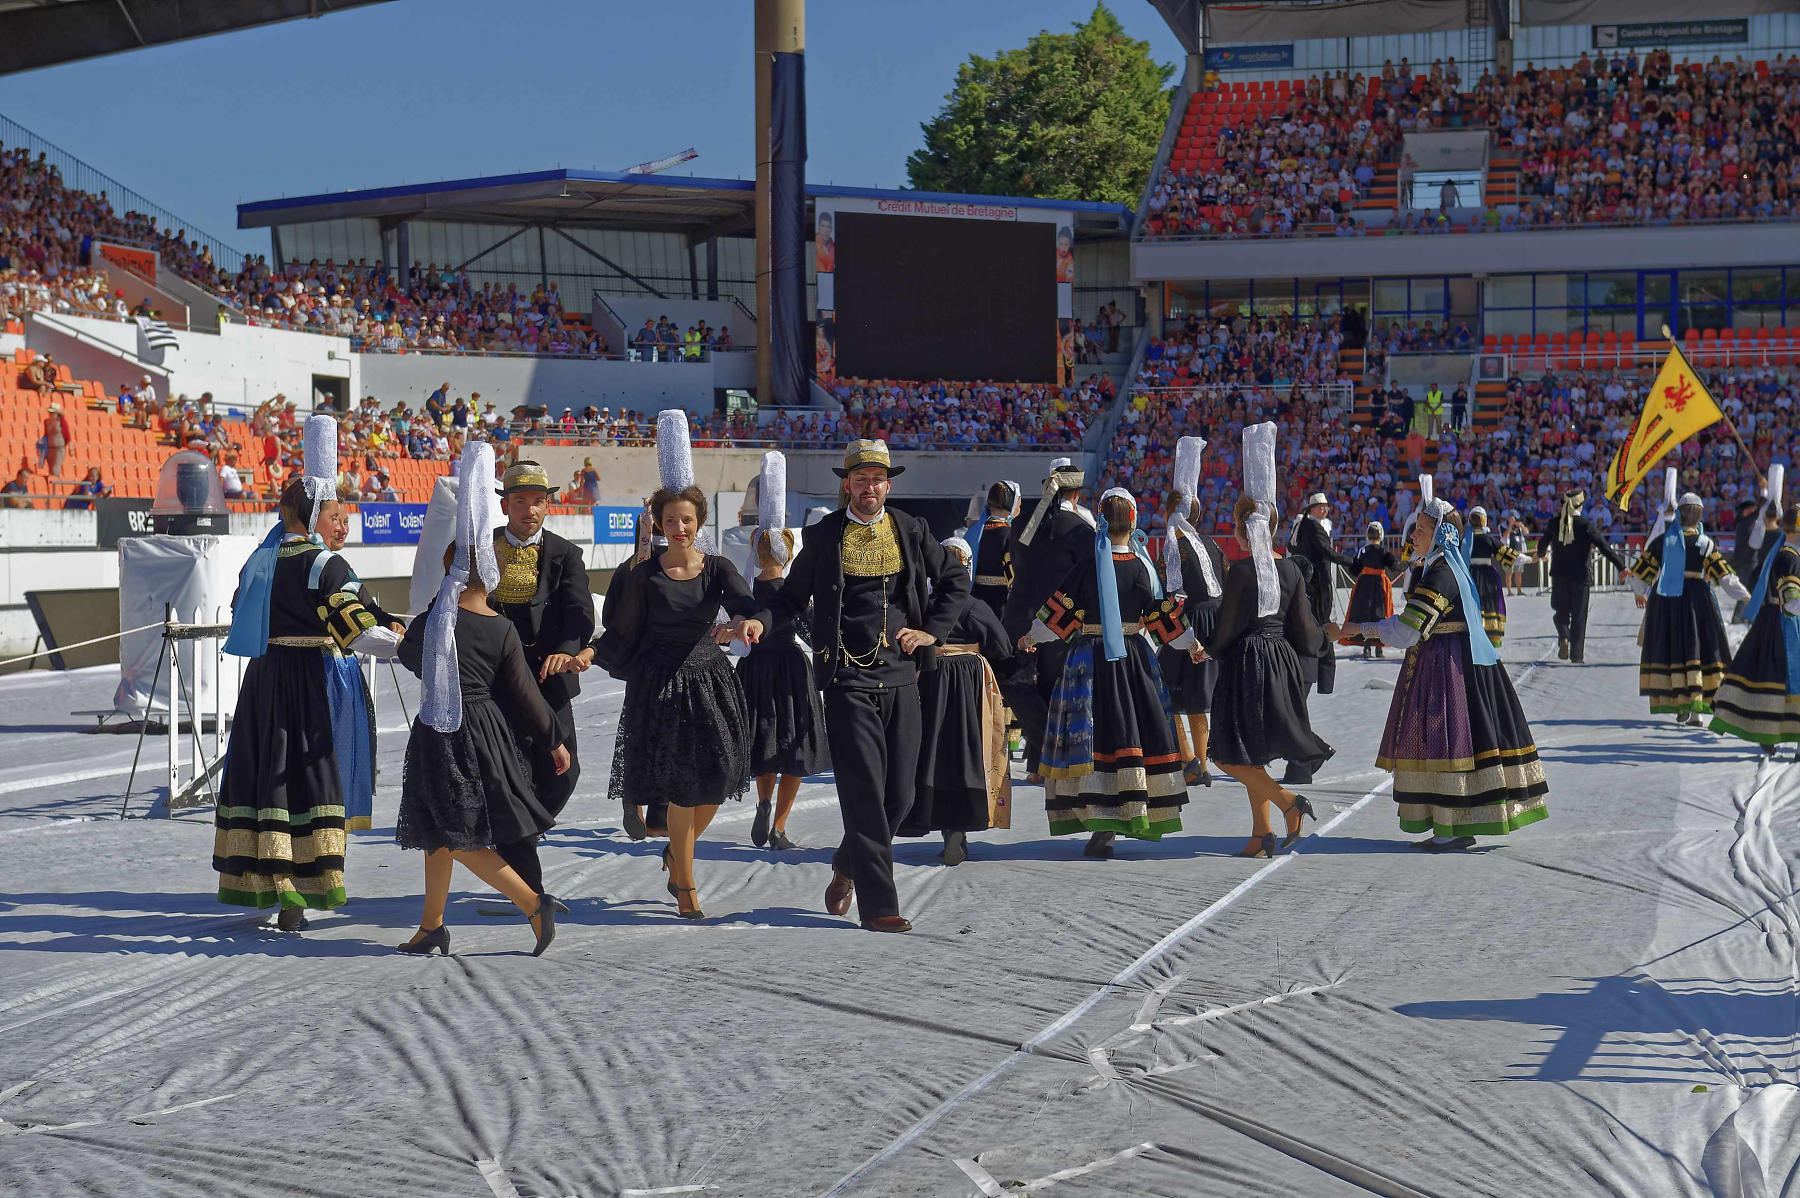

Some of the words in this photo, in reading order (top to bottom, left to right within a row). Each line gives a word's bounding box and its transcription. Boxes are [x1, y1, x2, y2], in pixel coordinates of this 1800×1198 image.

[1704, 24, 1743, 35] Bretagne
[879, 199, 911, 212] Crédit
[914, 202, 950, 214] Mutuel
[951, 204, 965, 216] de
[966, 204, 1014, 219] Bretagne
